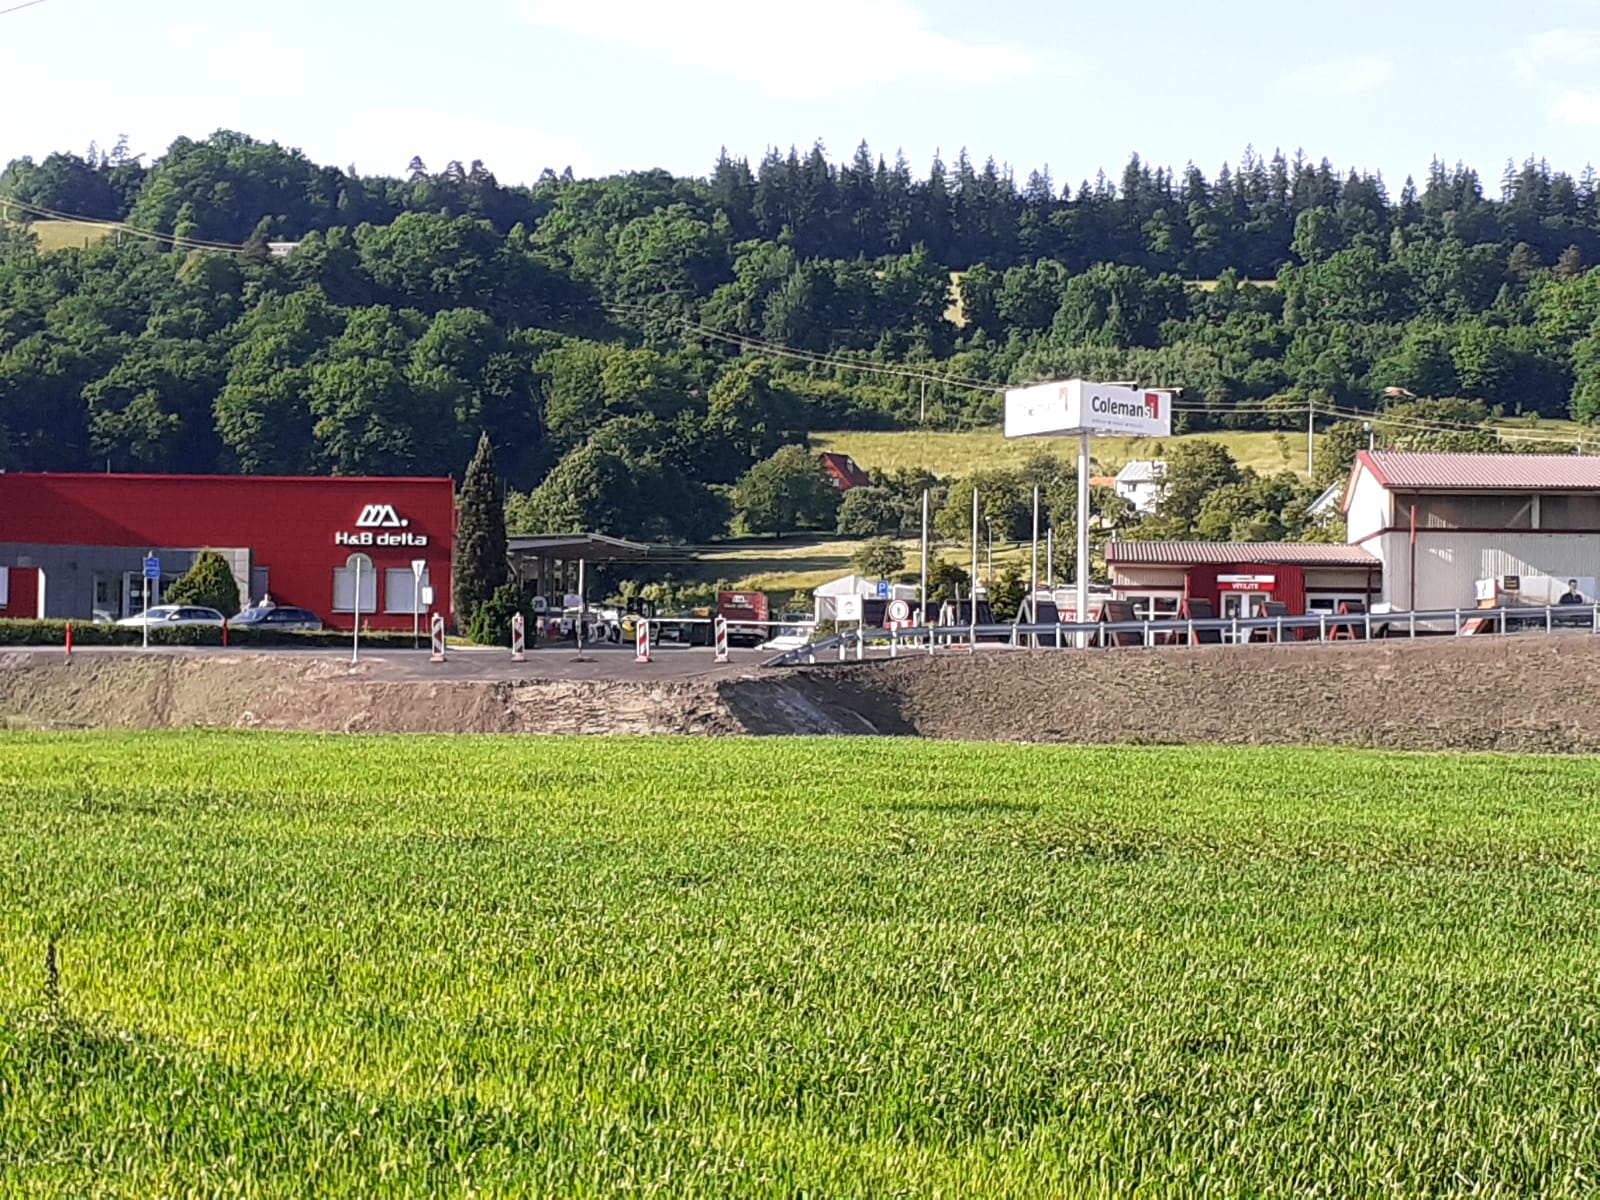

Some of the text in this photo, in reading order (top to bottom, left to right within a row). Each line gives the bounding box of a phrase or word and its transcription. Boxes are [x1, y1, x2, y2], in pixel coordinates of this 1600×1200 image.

[335, 531, 428, 546] H&B delta
[879, 583, 886, 593] P
